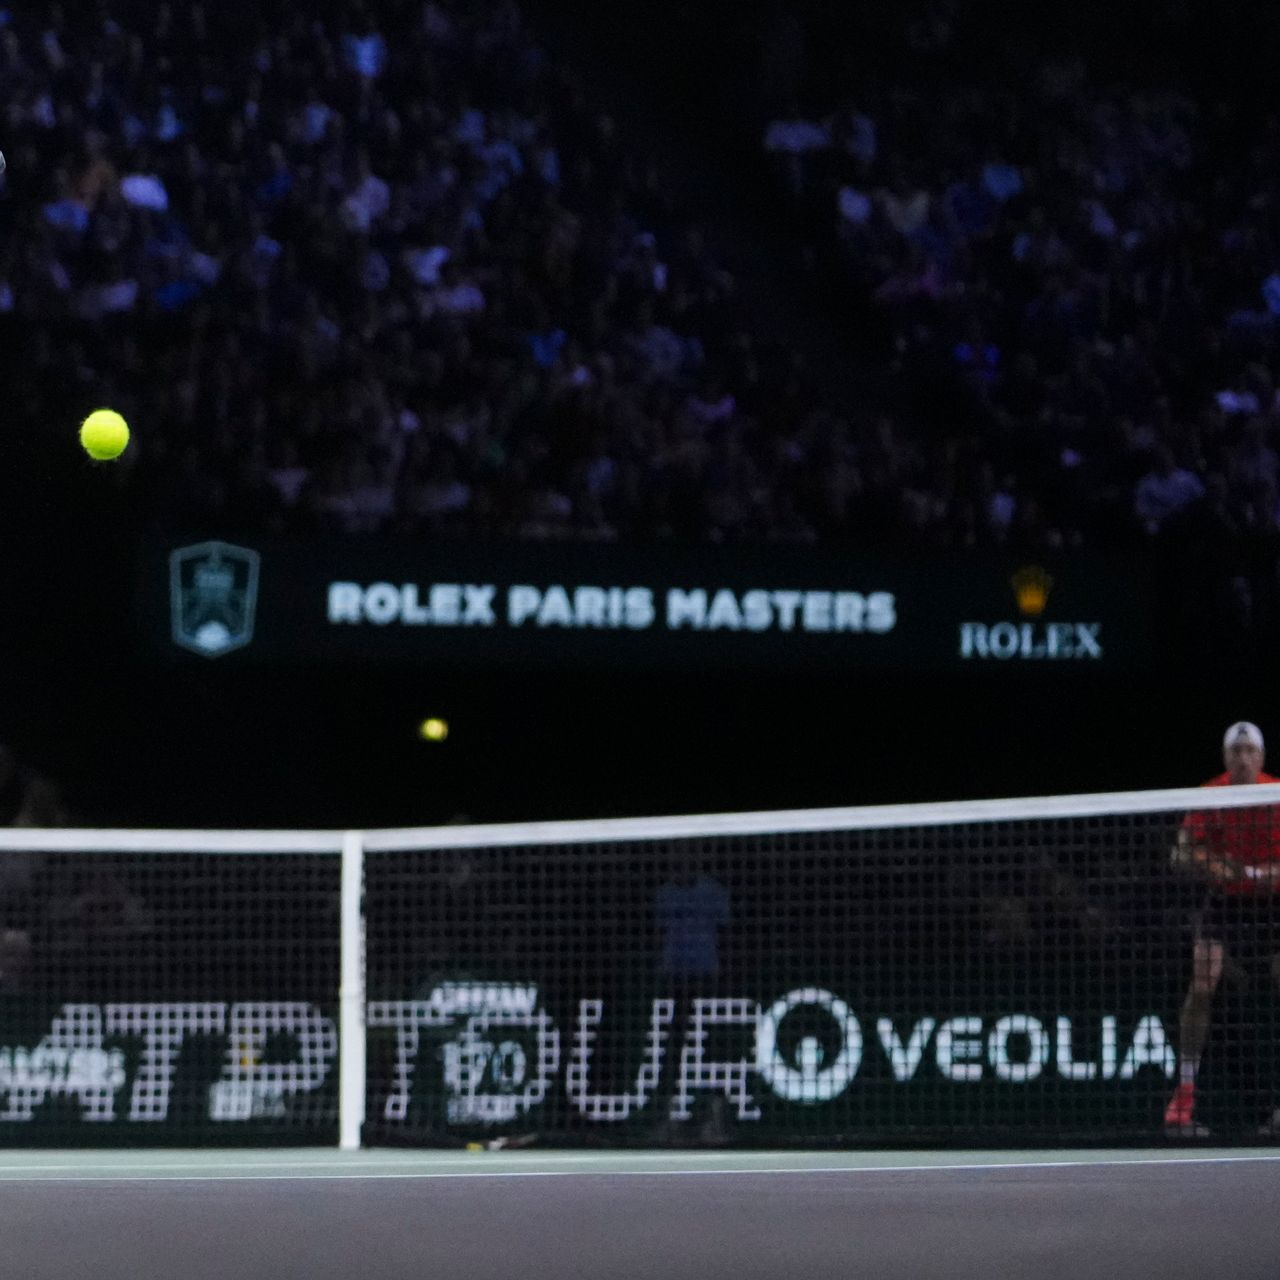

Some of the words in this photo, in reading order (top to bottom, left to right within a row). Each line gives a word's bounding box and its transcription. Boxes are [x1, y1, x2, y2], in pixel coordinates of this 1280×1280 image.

[327, 581, 496, 626] ROLEX
[507, 584, 656, 630] PARIS
[666, 587, 897, 633] MASTERS
[959, 622, 1102, 659] ROLEX
[876, 1015, 1176, 1082] VEOLIA
